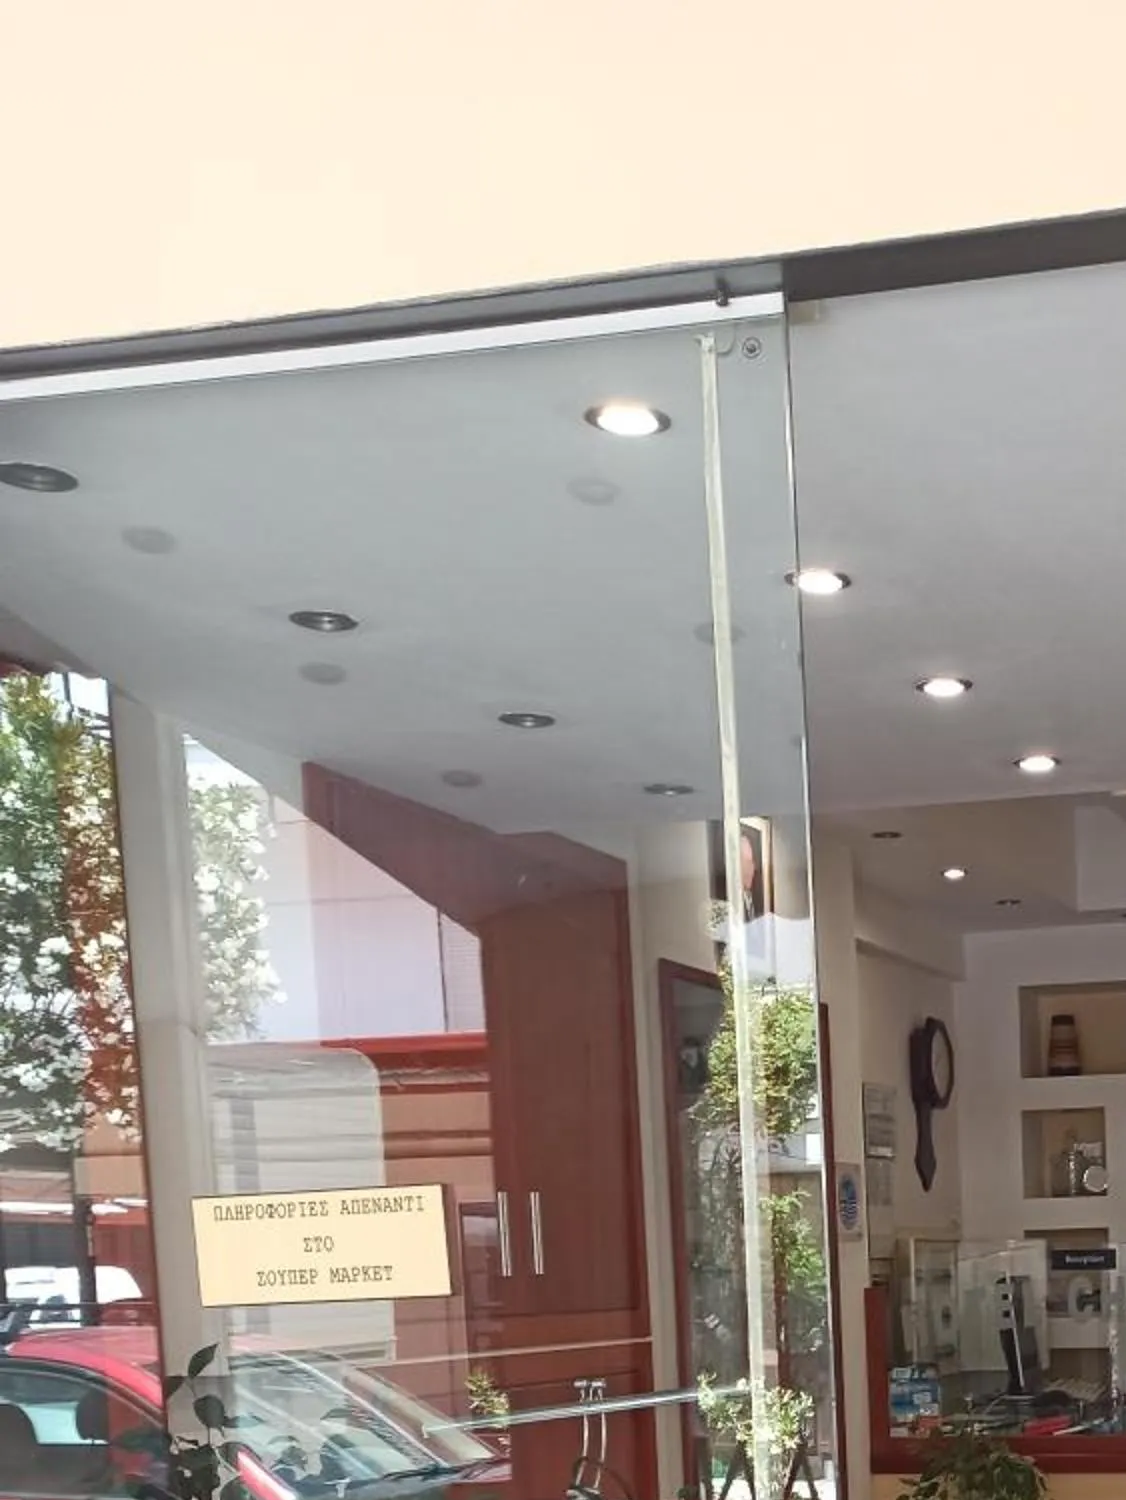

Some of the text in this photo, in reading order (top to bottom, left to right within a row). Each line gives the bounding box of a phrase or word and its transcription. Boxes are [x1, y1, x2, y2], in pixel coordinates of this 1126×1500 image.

[213, 1195, 425, 1221] ΠΛΗΡΟΦΟΡΙΕΣ ΑΠΕΝΑΝΤΙ
[303, 1236, 335, 1253] ΣΤΟ
[257, 1265, 393, 1287] ΣΟΥΠΕΡ ΜΑΡΚΕΤ
